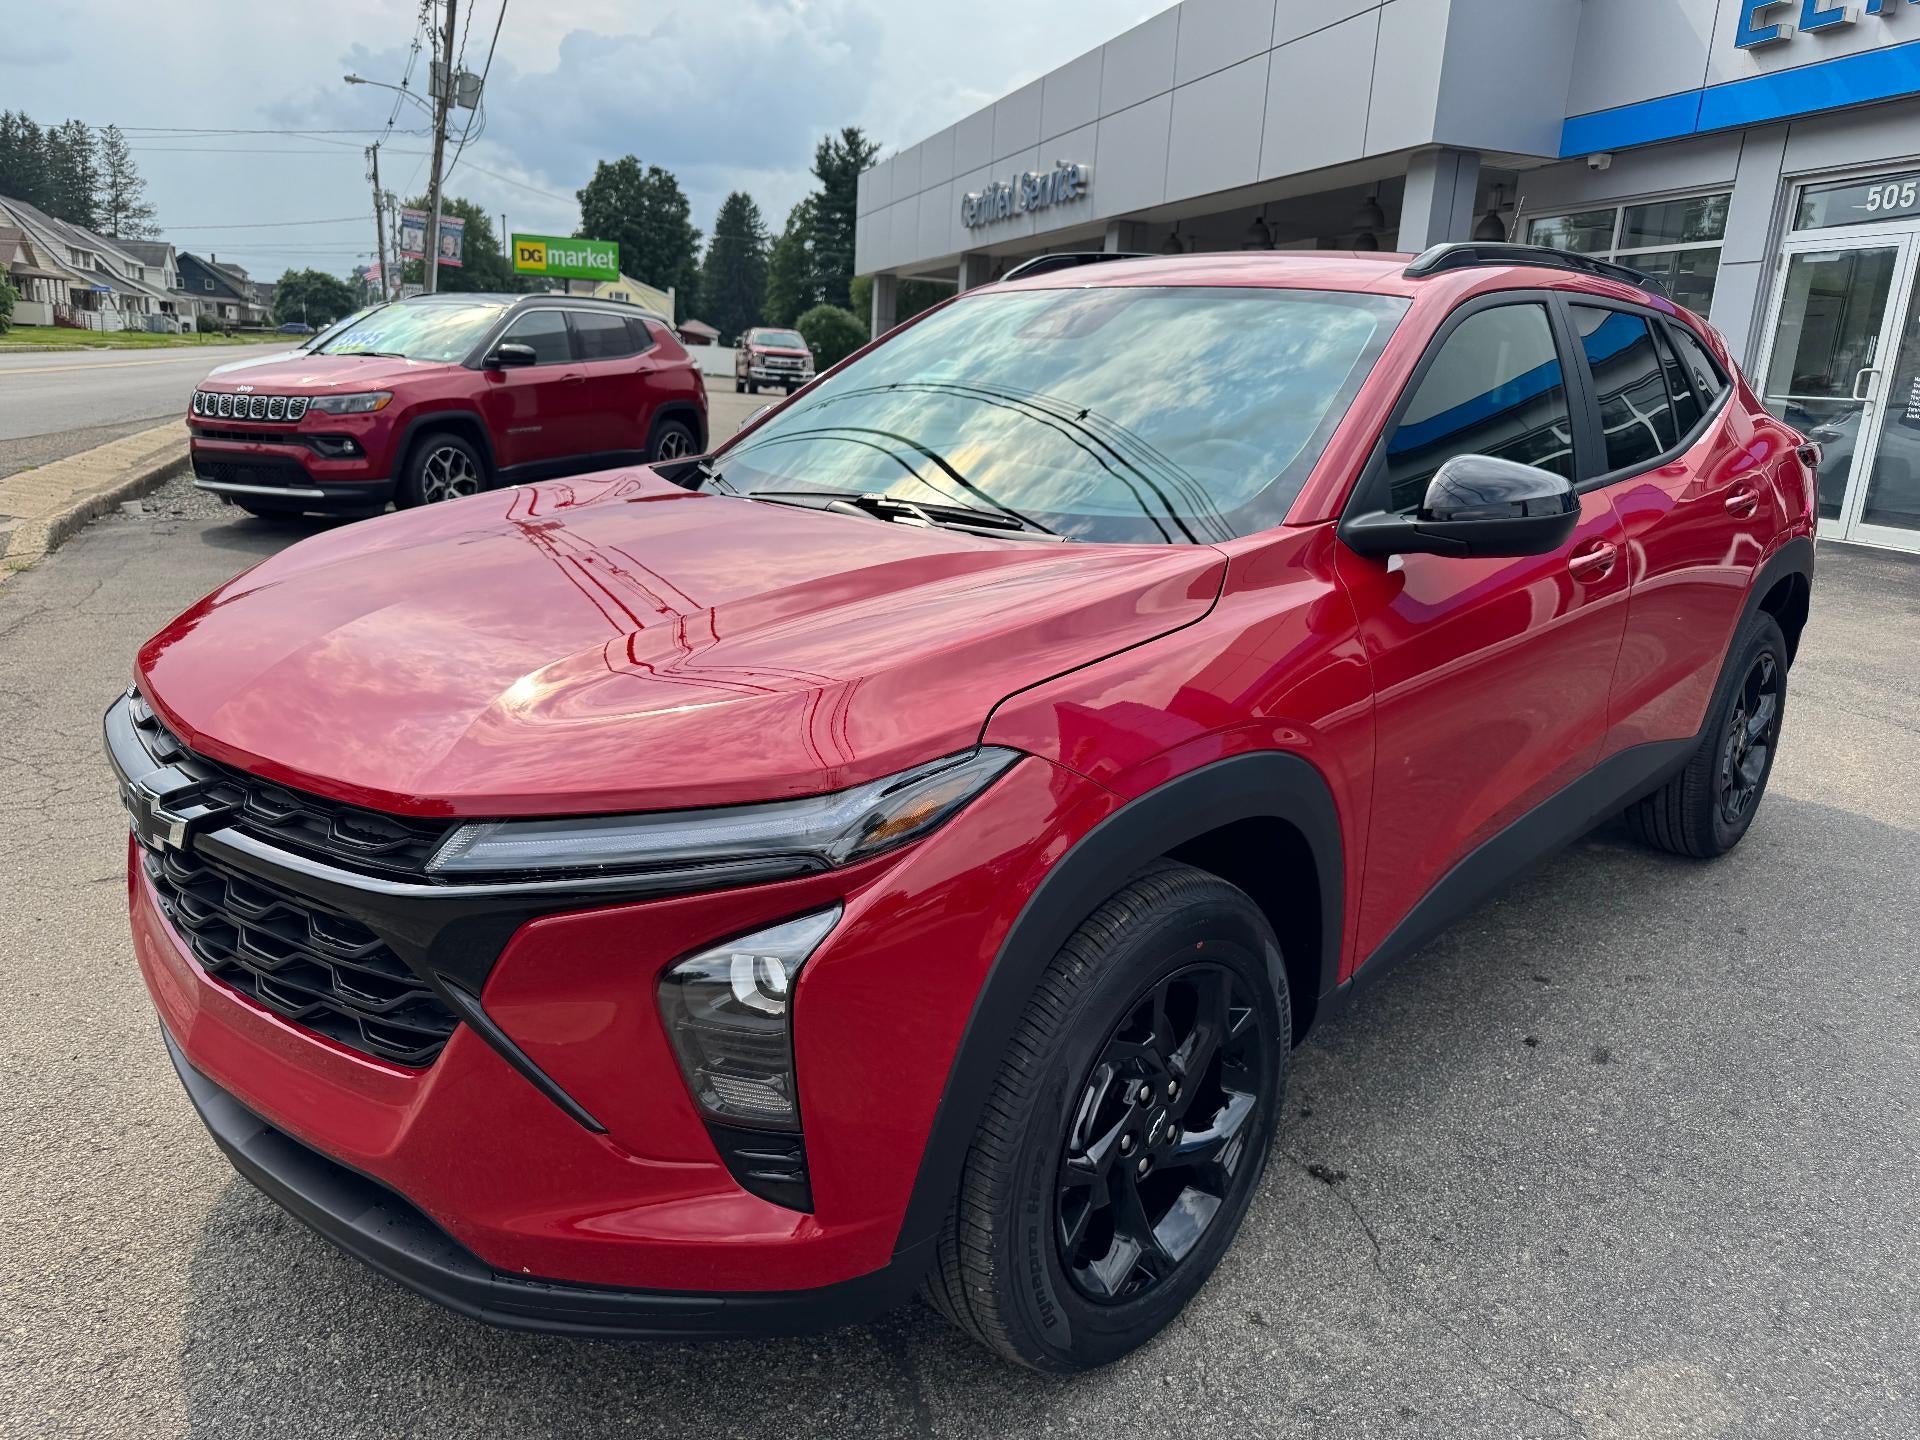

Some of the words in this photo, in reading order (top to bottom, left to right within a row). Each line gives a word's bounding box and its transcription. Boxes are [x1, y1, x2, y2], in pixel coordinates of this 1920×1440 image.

[962, 174, 1017, 228] Certified
[1021, 160, 1085, 211] Service
[1866, 182, 1917, 212] 505
[519, 248, 542, 262] DG
[548, 248, 615, 269] market
[237, 385, 253, 393] Jeep
